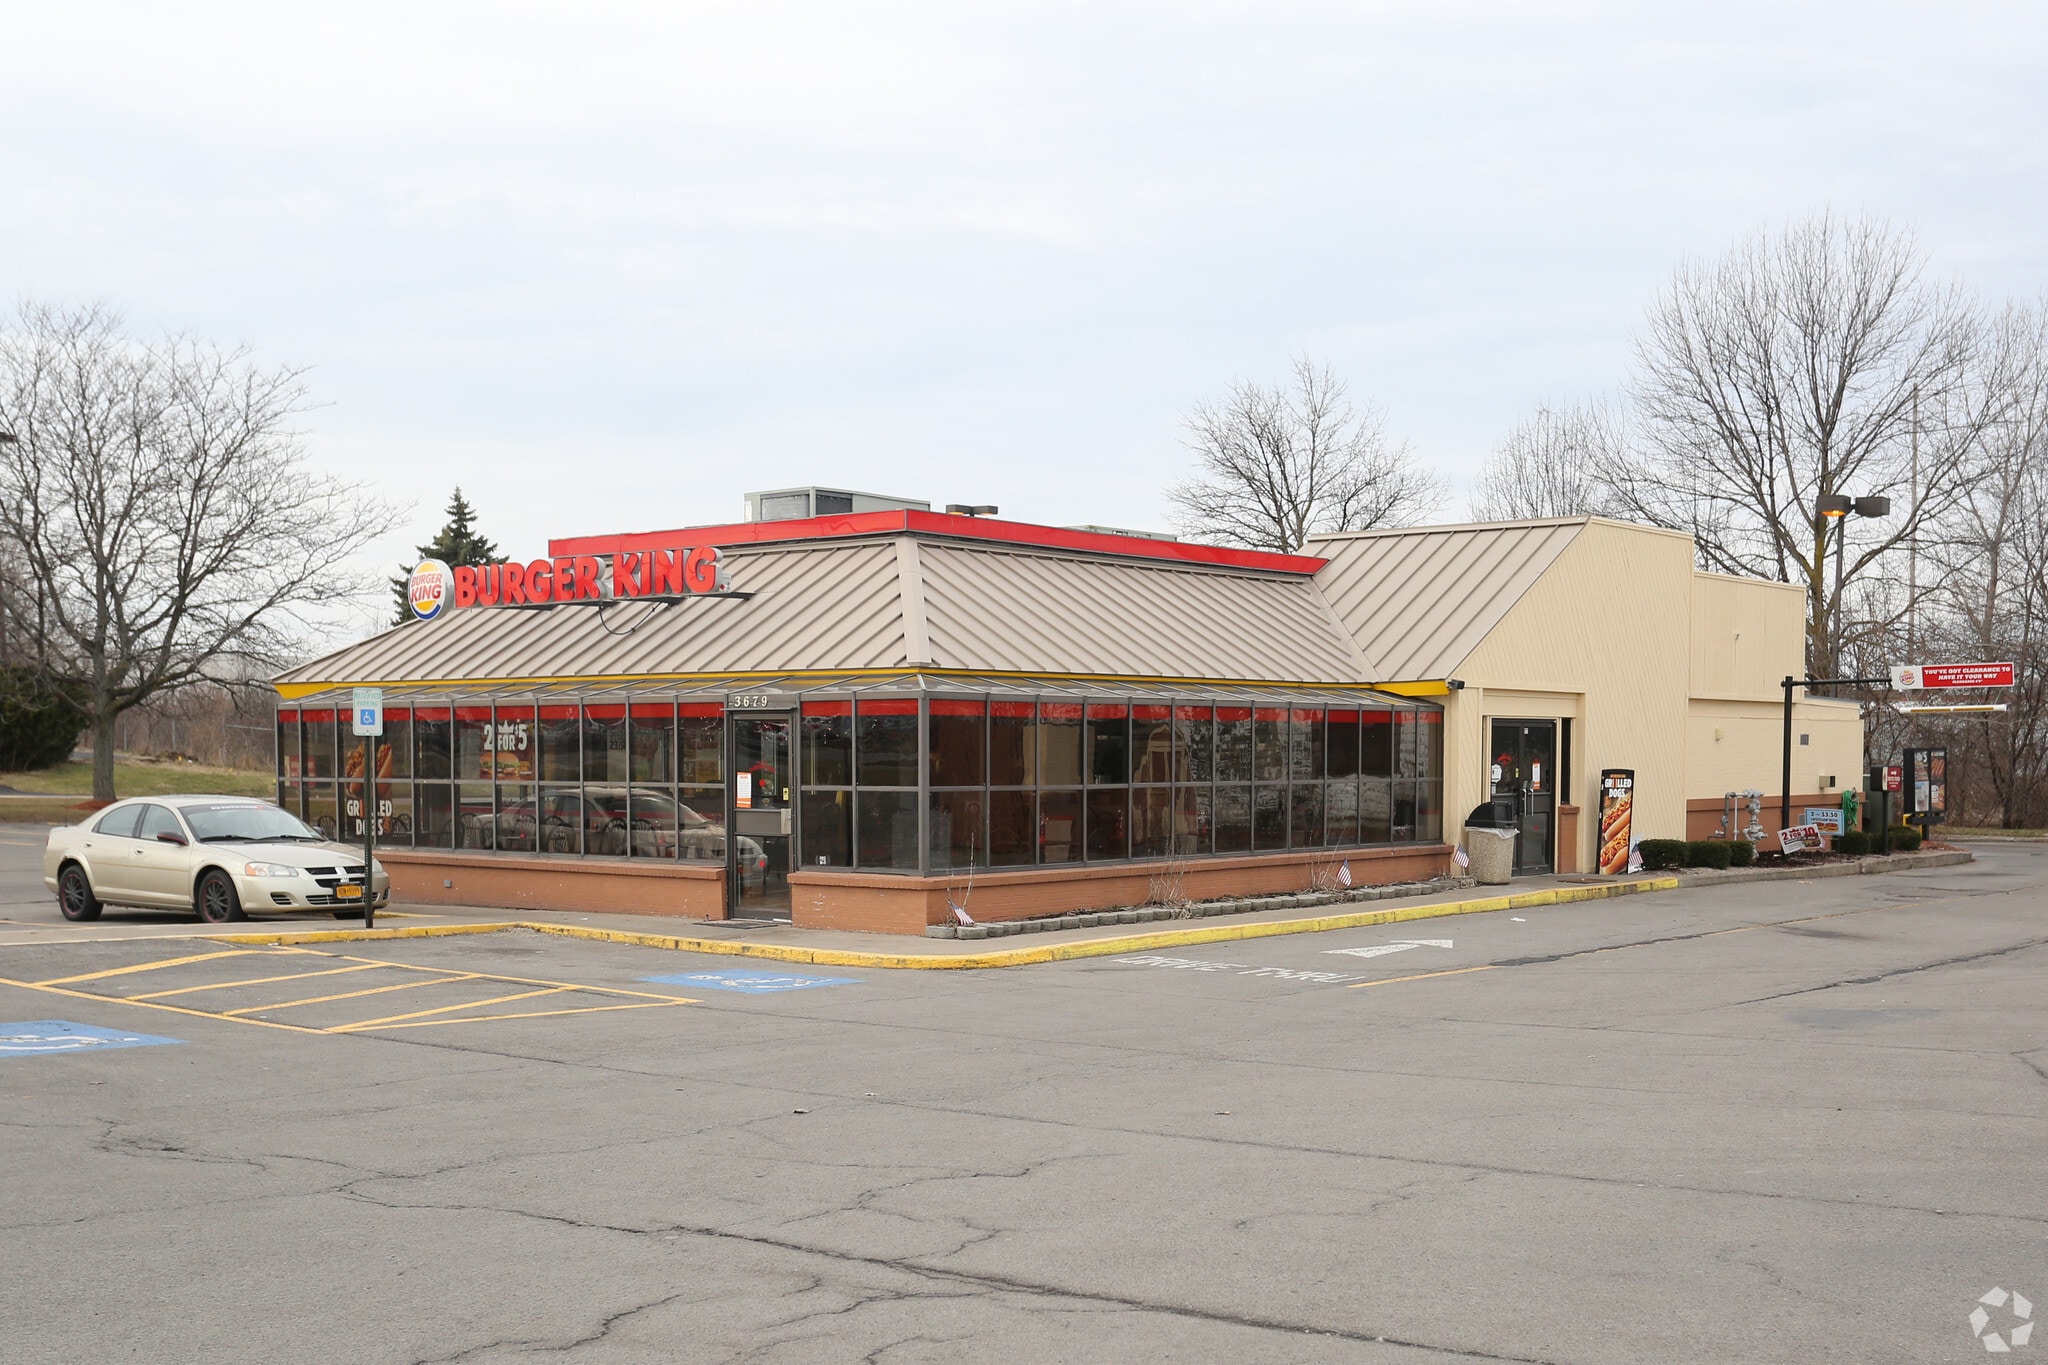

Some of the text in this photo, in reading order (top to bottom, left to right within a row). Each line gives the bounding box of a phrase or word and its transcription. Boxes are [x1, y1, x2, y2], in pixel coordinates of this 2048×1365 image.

[411, 573, 443, 587] BURGER
[454, 547, 718, 608] BURGER KING
[411, 584, 442, 603] KING
[734, 695, 768, 708] 3679
[484, 724, 495, 750] 2
[497, 734, 516, 751] FOR
[1605, 778, 1632, 788] GRILLED
[1609, 788, 1626, 798] DOGS
[347, 799, 393, 817] GRIED
[1781, 831, 1789, 841] 2
[1110, 955, 1368, 984] DRIVE THRU
